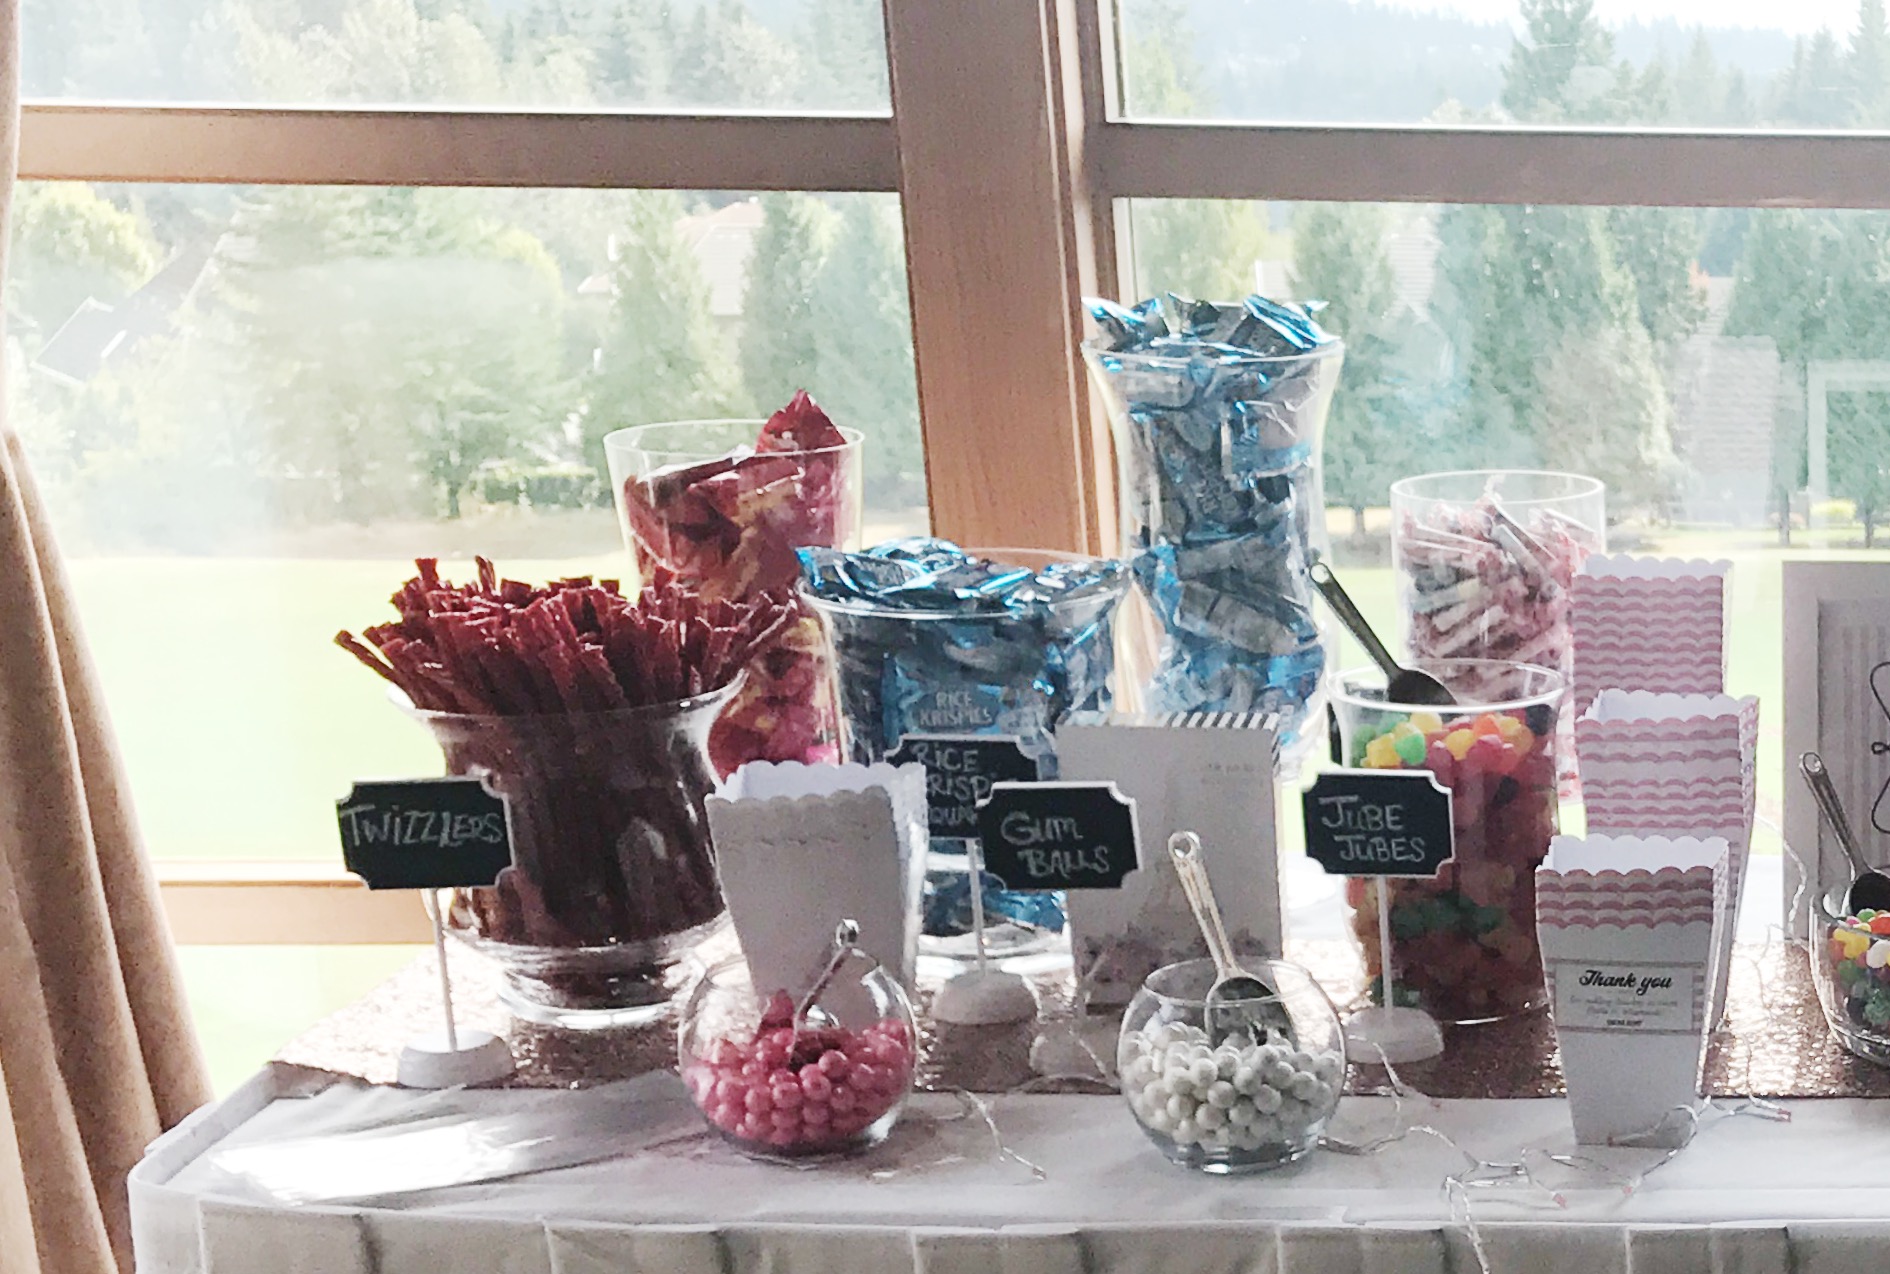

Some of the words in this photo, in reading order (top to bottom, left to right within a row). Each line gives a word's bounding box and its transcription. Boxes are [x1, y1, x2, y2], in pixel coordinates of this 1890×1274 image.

[1017, 846, 1110, 879] BALLS
[1578, 969, 1637, 988] Thank
[1636, 976, 1673, 996] you
